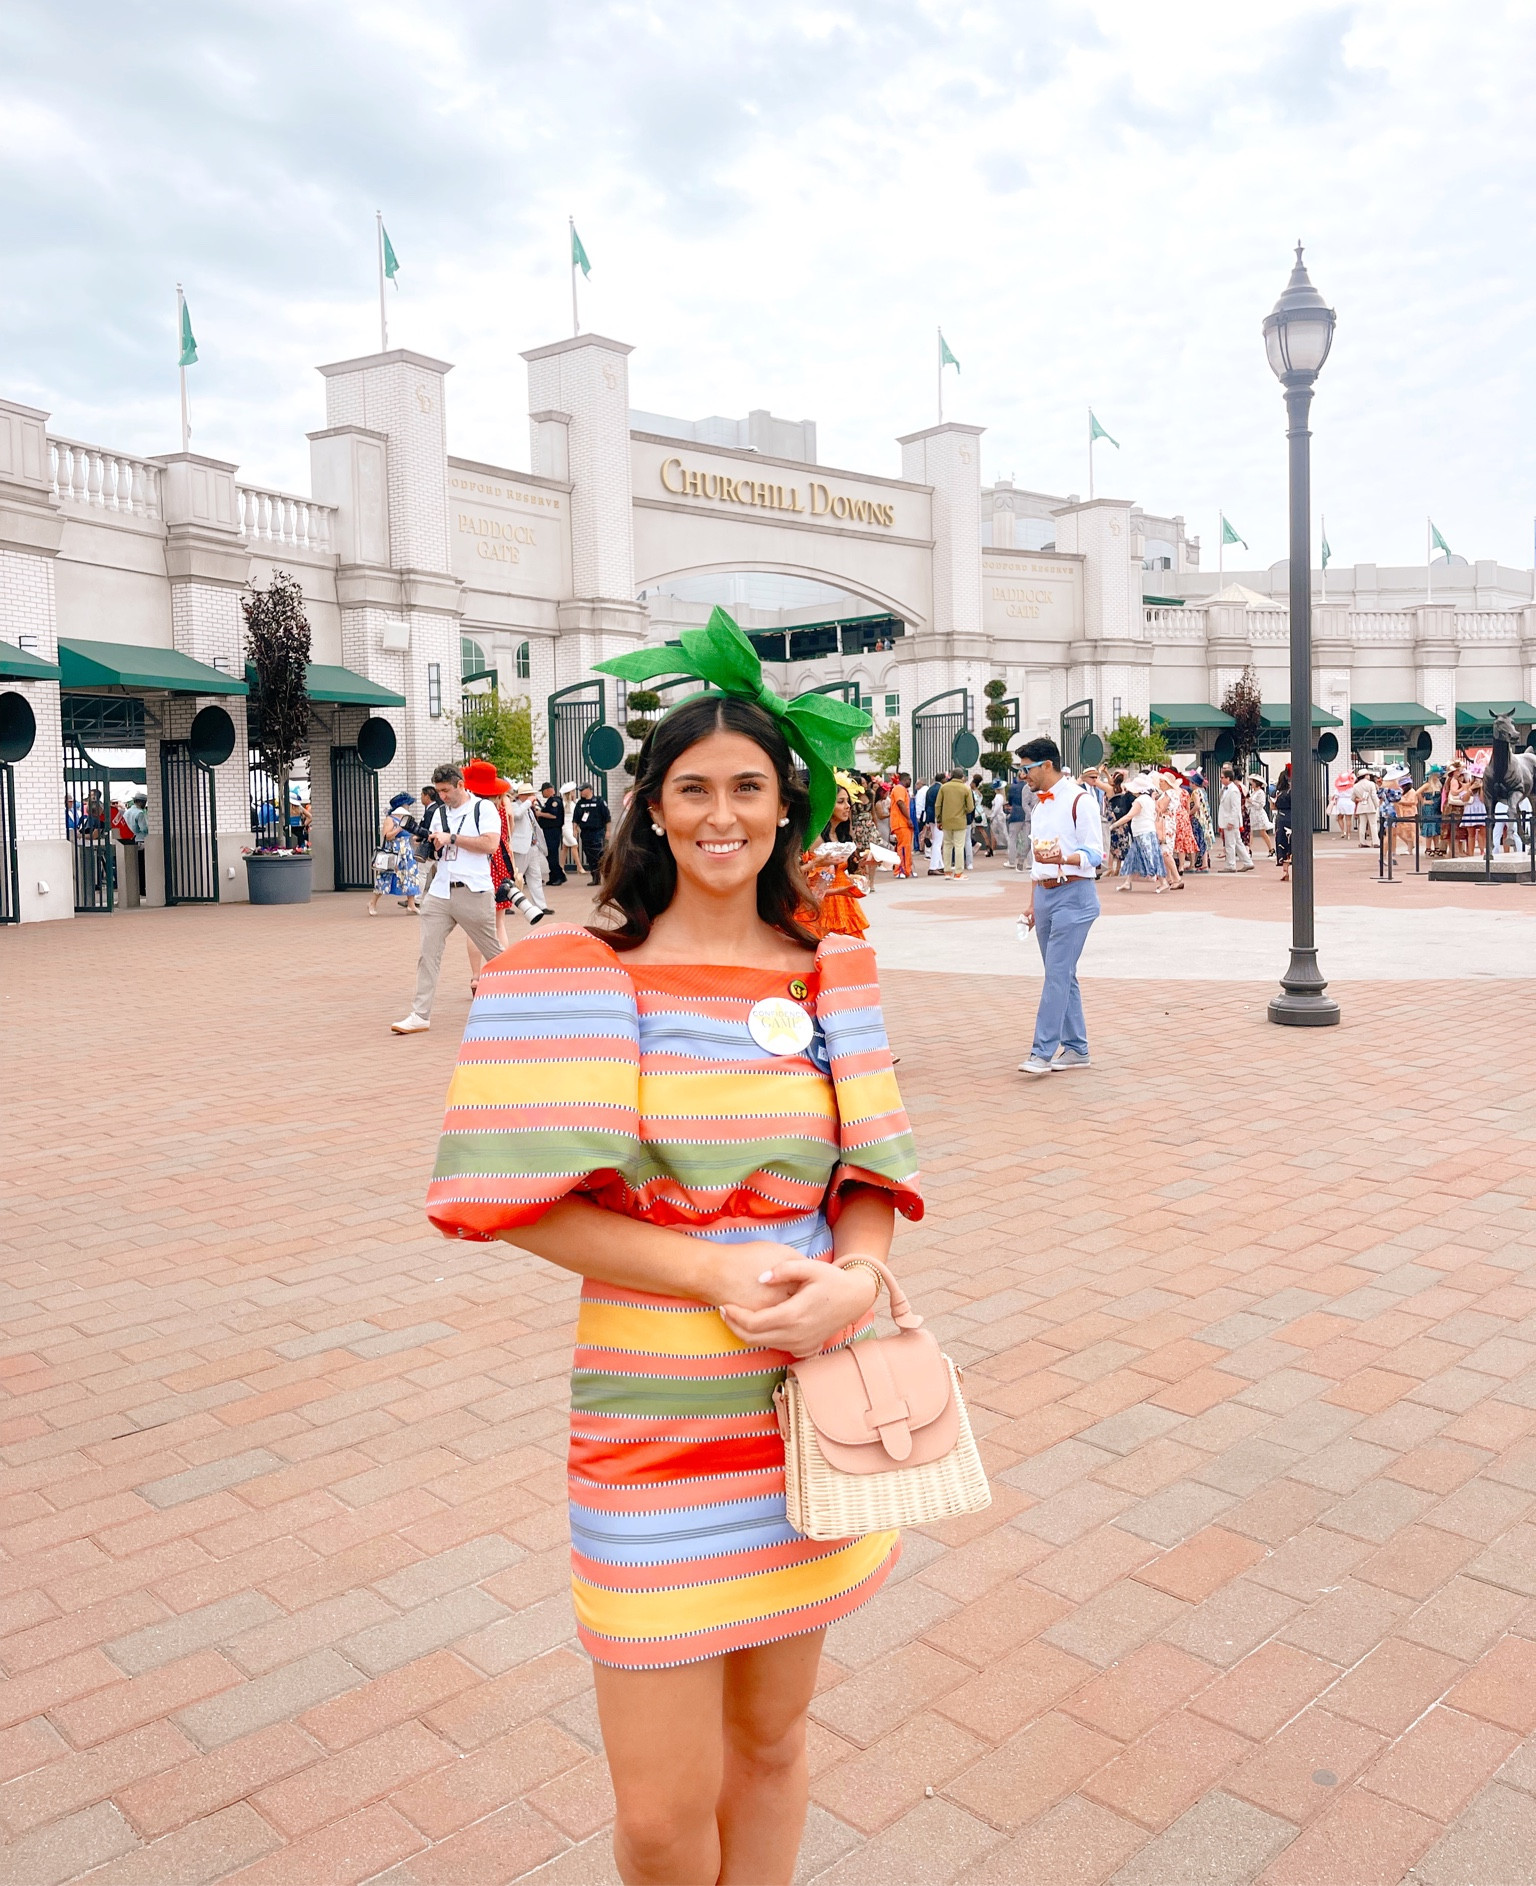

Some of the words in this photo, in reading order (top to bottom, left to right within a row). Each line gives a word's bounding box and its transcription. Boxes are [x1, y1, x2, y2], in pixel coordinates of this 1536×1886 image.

[449, 478, 502, 497] ODFORD
[506, 489, 560, 509] RESERVE
[660, 457, 805, 513] CHURCHILL
[809, 481, 896, 527] DOWNS
[458, 514, 537, 546] PADDOCK
[477, 541, 520, 564] GATE
[982, 561, 1028, 571] OODFORD
[1031, 564, 1074, 574] RESERVE
[992, 587, 1054, 604] PADDOCK
[1006, 604, 1040, 619] GATE
